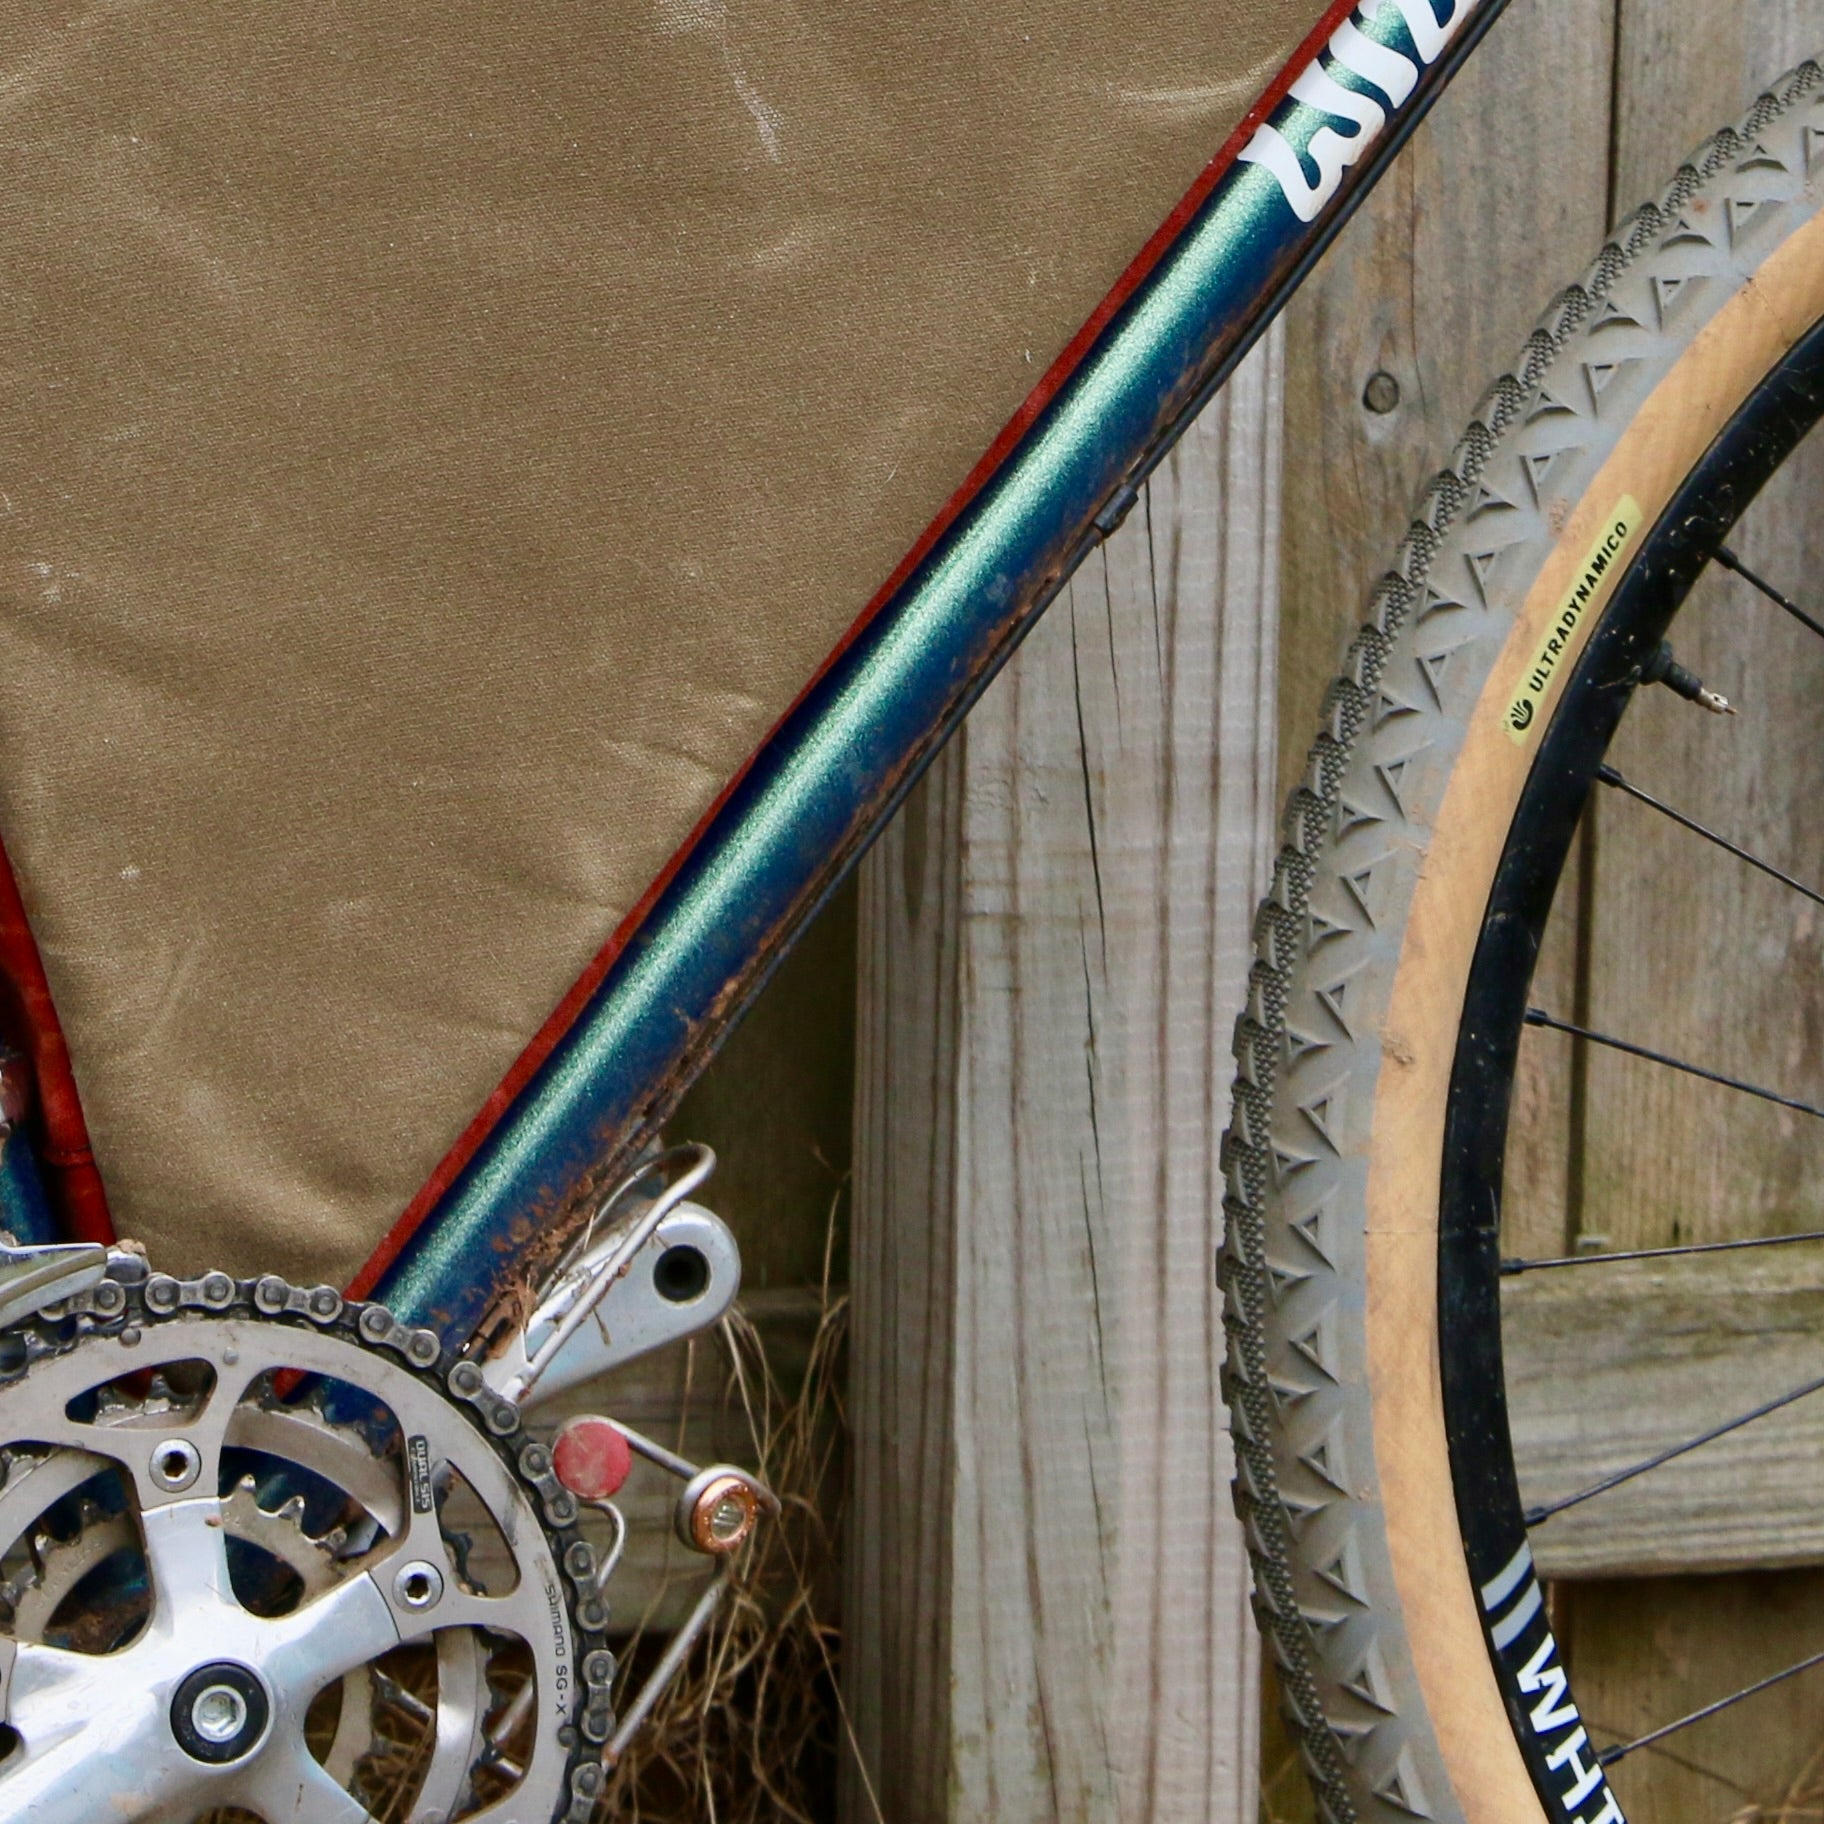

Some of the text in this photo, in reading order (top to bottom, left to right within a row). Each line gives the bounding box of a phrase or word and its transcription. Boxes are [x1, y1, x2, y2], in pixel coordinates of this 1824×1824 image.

[1529, 520, 1628, 693] ULTRADYNAMICO
[420, 1482, 432, 1510] SIS
[544, 1582, 566, 1657] SHIMANO
